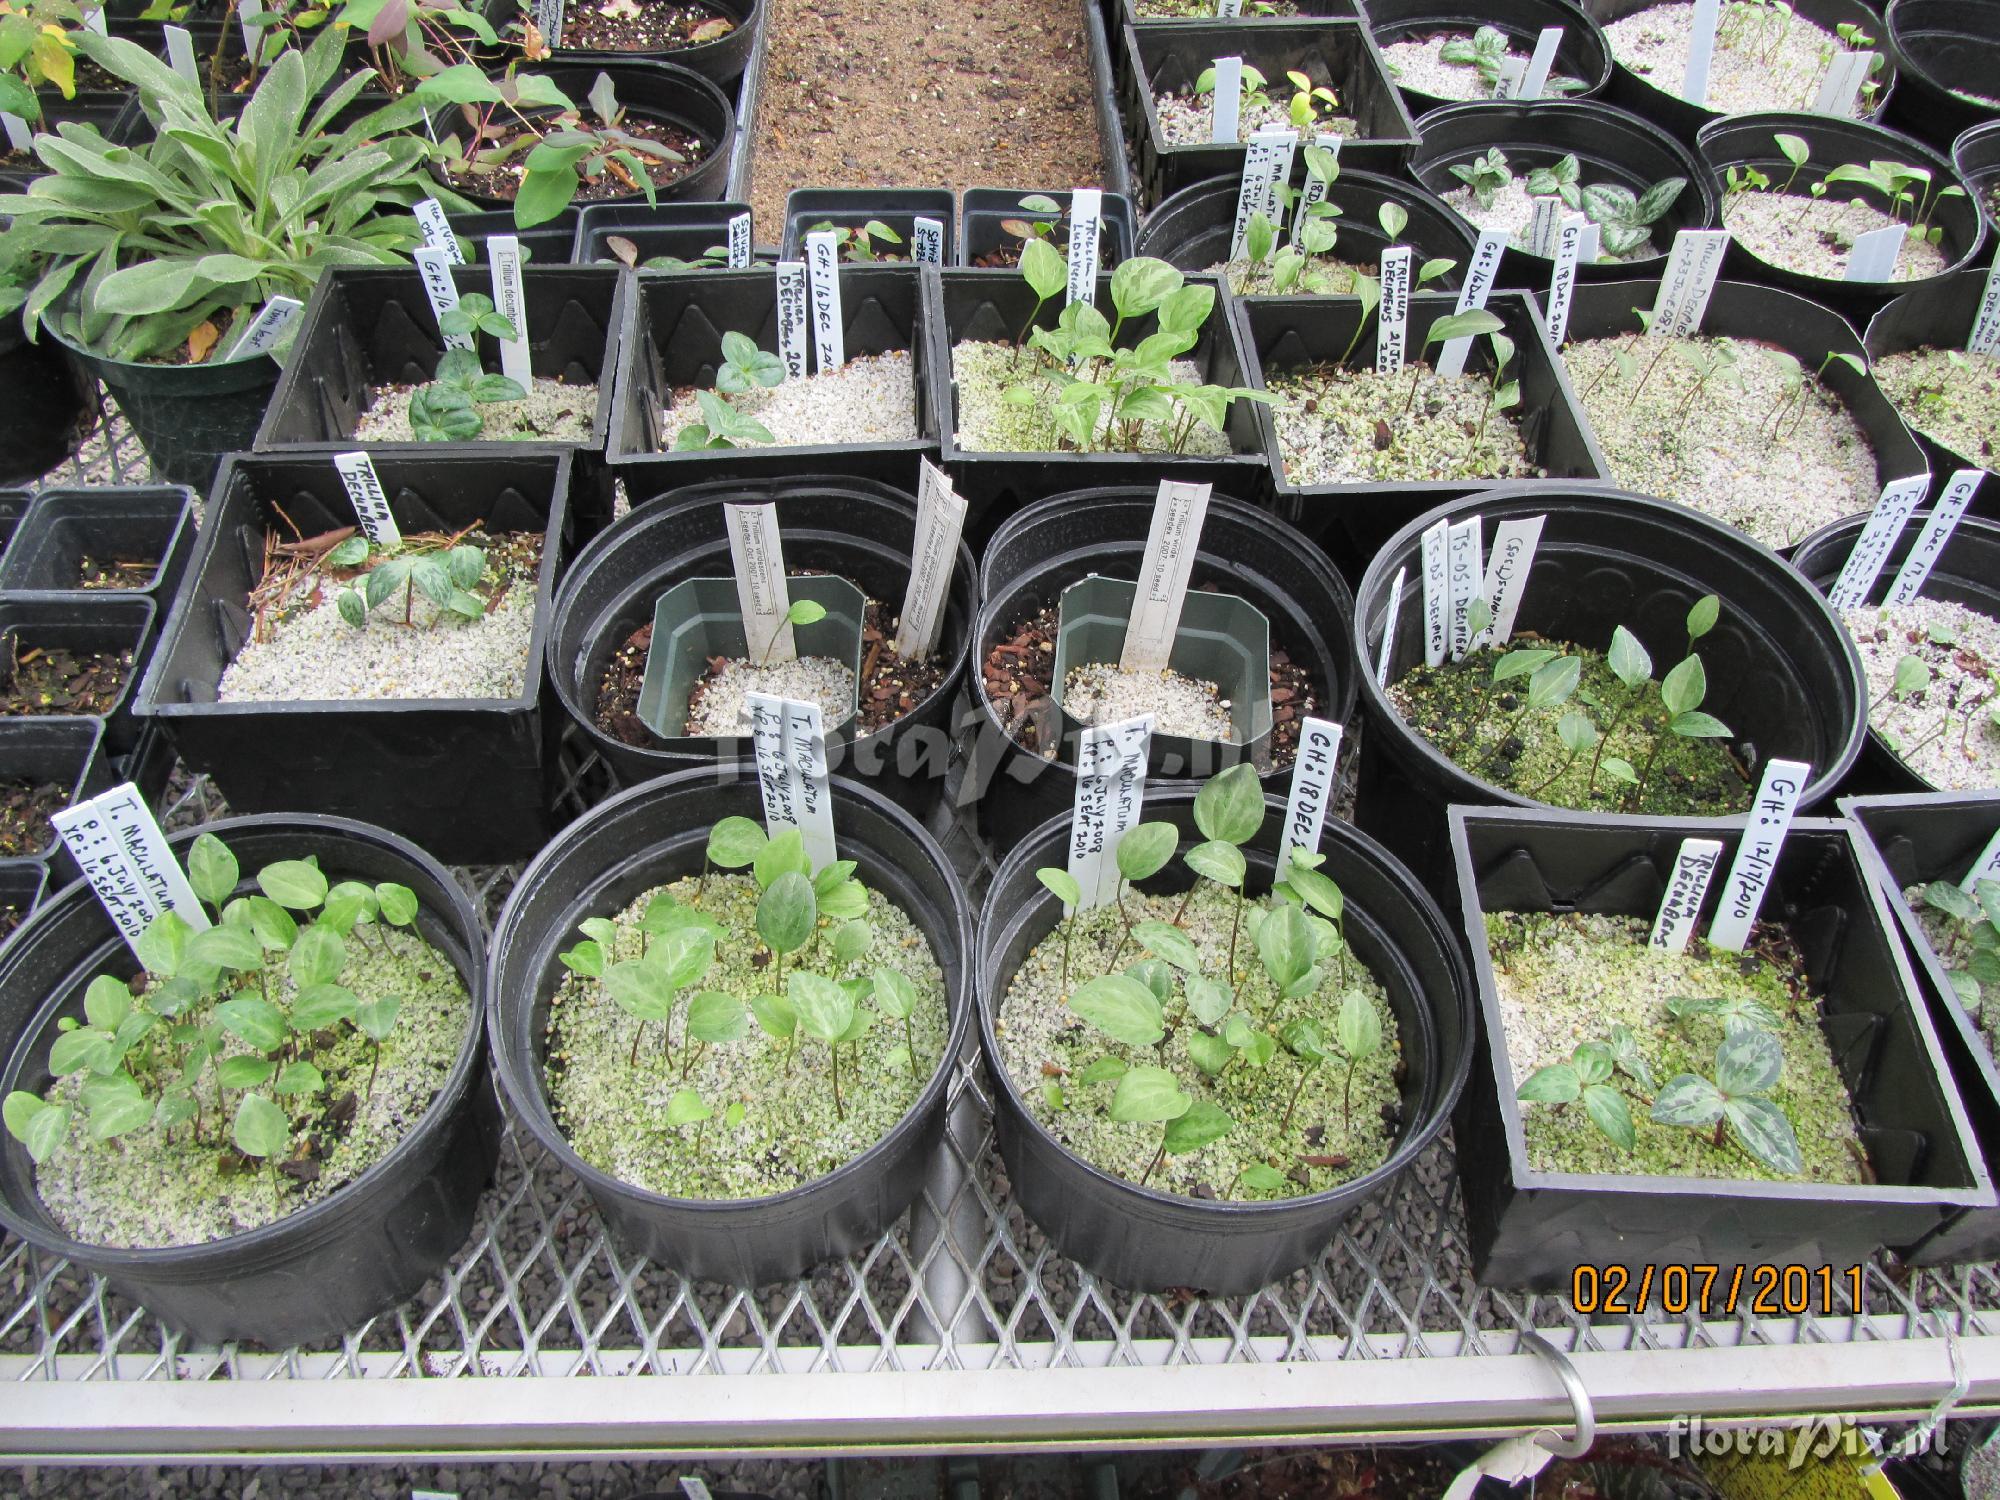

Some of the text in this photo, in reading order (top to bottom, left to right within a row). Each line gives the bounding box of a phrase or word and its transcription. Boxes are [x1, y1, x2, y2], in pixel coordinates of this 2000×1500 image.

[502, 260, 514, 287] Trillium
[356, 460, 390, 521] TRILLIUM
[752, 521, 760, 545] Trillium
[1176, 510, 1189, 537] Trillium
[1124, 722, 1148, 741] T.
[791, 714, 818, 815] T. MACULATUM
[1304, 732, 1331, 776] GH:
[1759, 779, 1796, 826] GH:
[111, 797, 176, 912] T. MACULATUM
